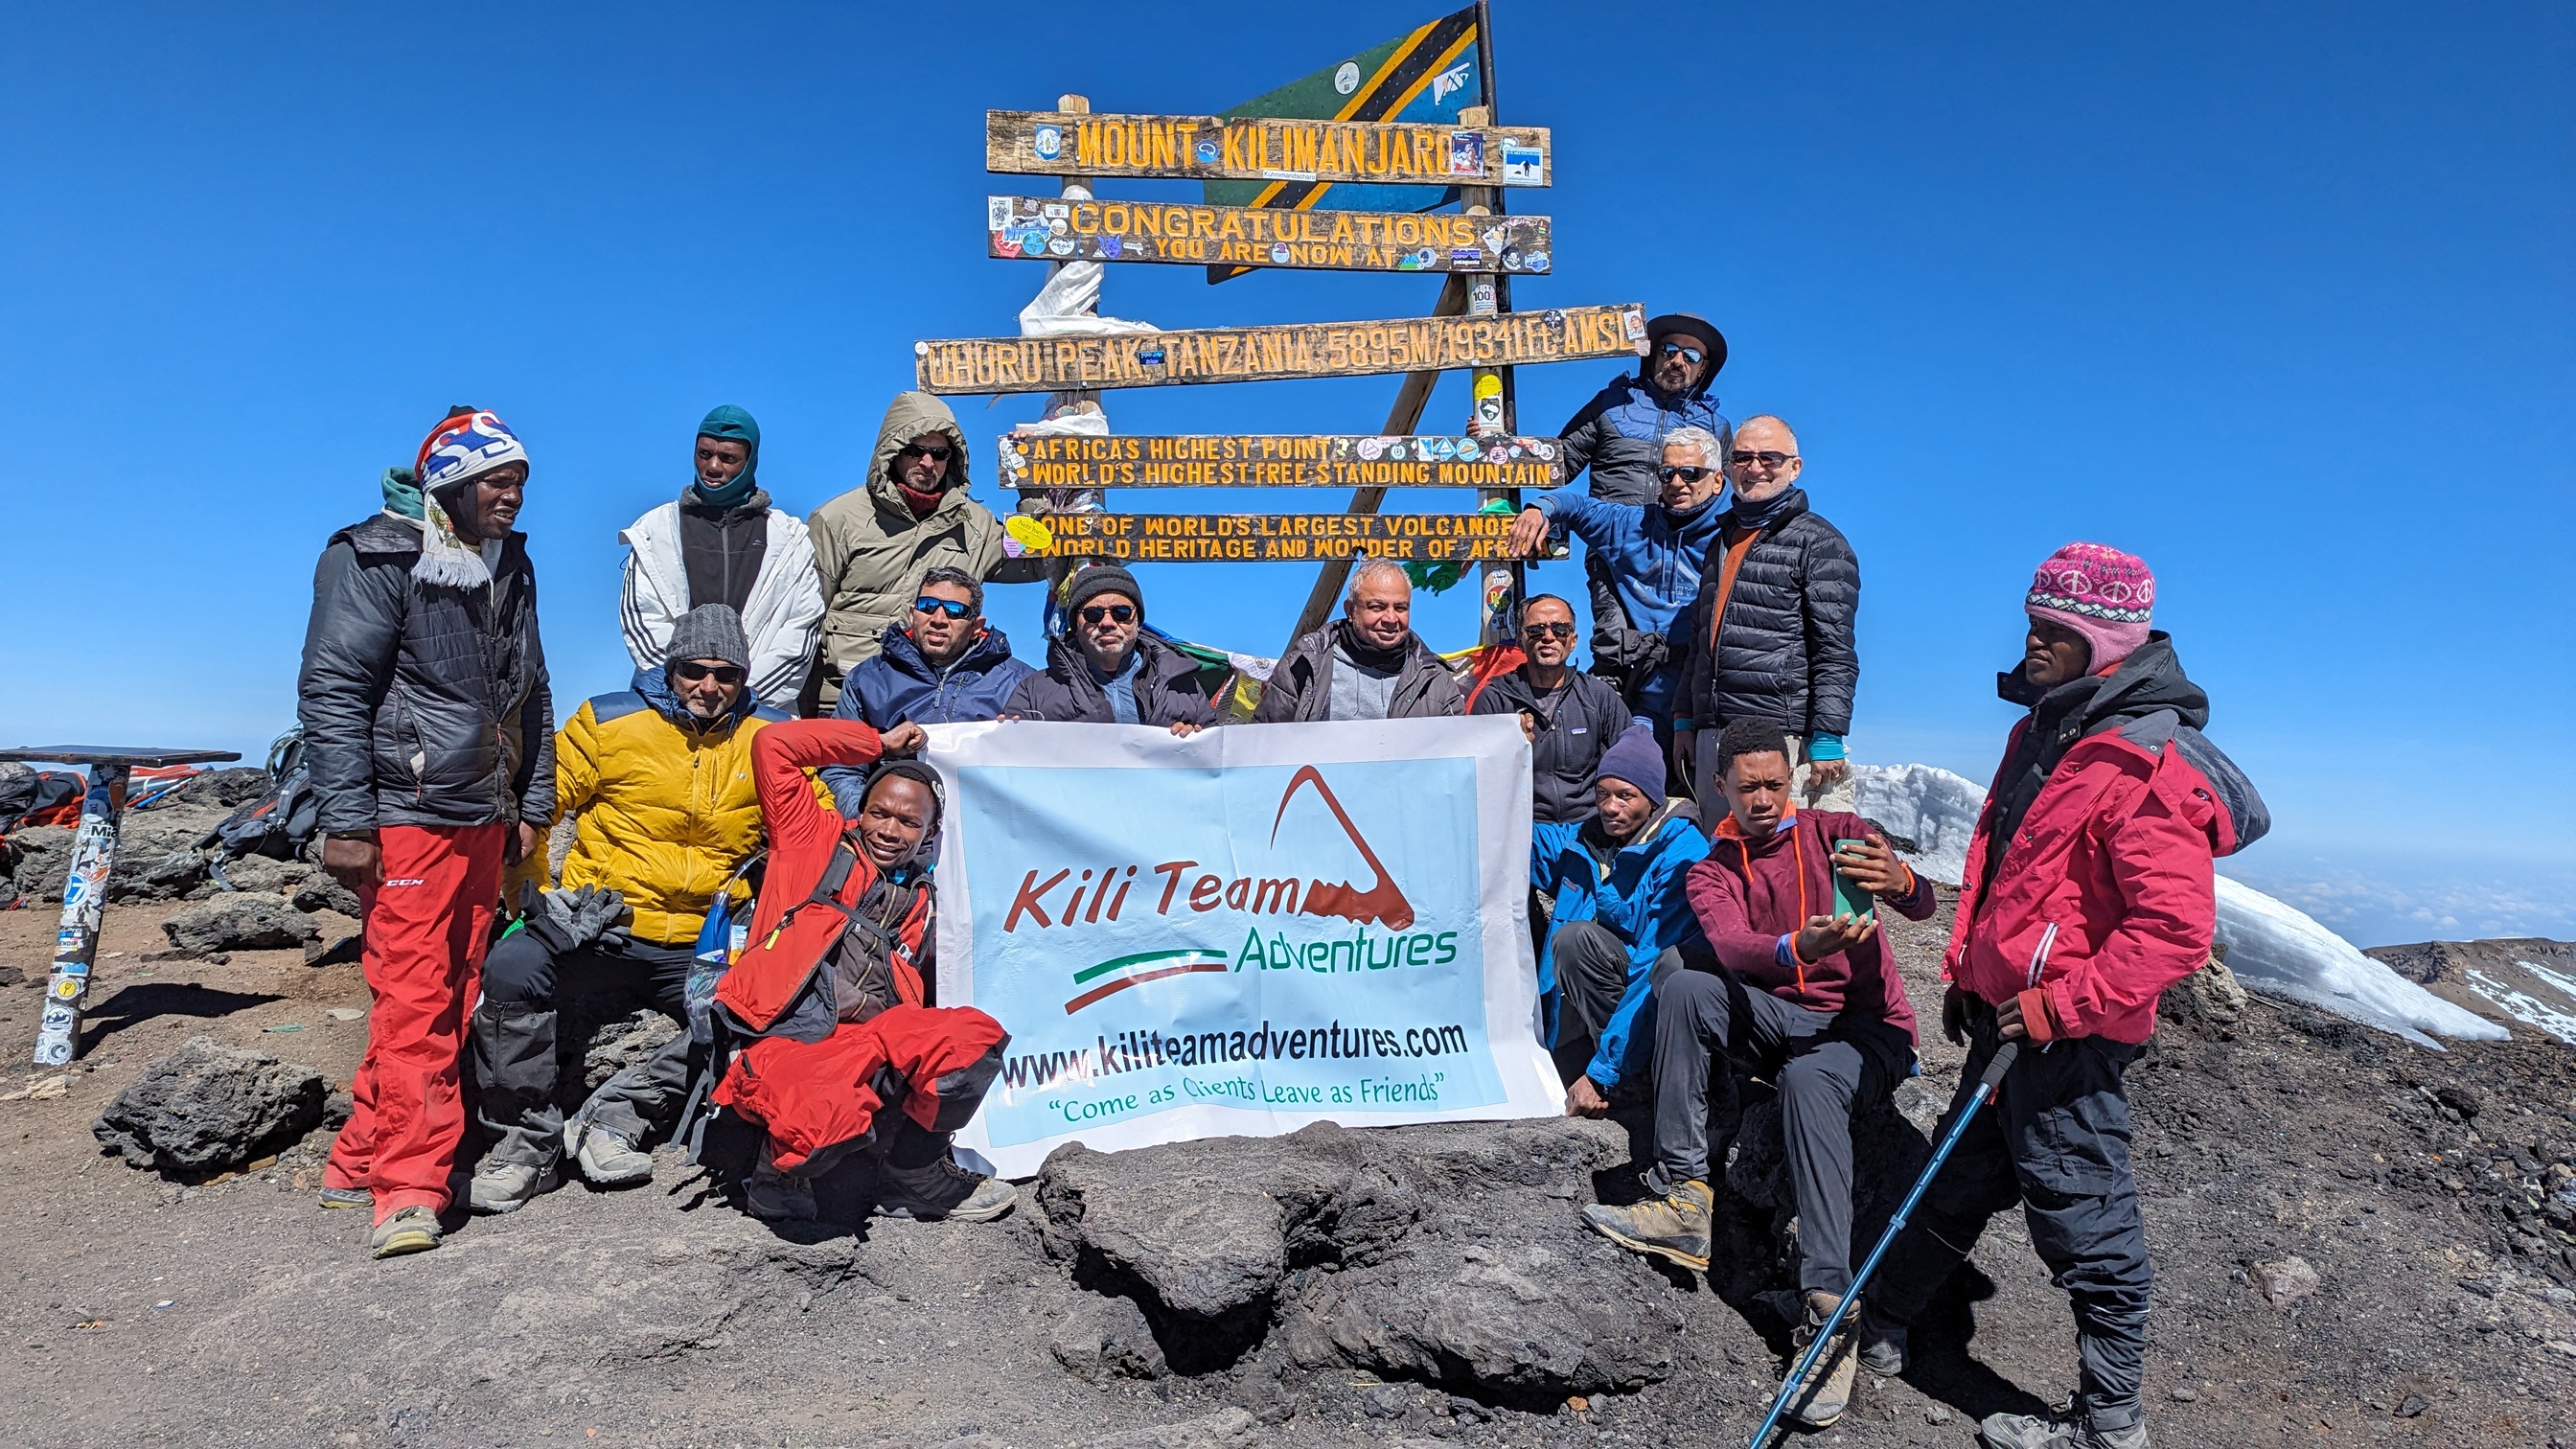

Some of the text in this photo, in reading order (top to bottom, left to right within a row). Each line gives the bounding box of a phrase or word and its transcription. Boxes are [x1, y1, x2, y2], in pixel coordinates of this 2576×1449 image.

[1077, 121, 1452, 175] MOUNT KILIMANJARO
[1070, 202, 1476, 246] CONGRATULATIONS
[1155, 239, 1397, 267] YOU ARE NOW AT
[1473, 291, 1491, 302] 100
[929, 341, 1042, 387] UHURU
[1563, 311, 1636, 355] AMSL
[1033, 438, 1331, 460] AFRICA'S HIGHEST POINT
[1033, 462, 1136, 485] WORLD'S
[1145, 462, 1249, 485] HIGHEST
[1438, 462, 1552, 485] MOUNTAIN
[1041, 515, 1516, 537] ONE OF WORLD'S LARGEST VOLCANOE
[1041, 538, 1131, 558] WORLD
[1139, 538, 1257, 558] HERITAGE
[1265, 538, 1308, 558] AND
[1428, 539, 1458, 558] OF
[1471, 539, 1552, 558] AFRA
[1002, 861, 1301, 934] Kili Team
[1234, 926, 1459, 974] Adventures
[1000, 1019, 1469, 1090] www.kiliteamadventures.com
[1148, 1084, 1176, 1104] as
[1260, 1079, 1322, 1103] Leave
[1329, 1085, 1353, 1103] as
